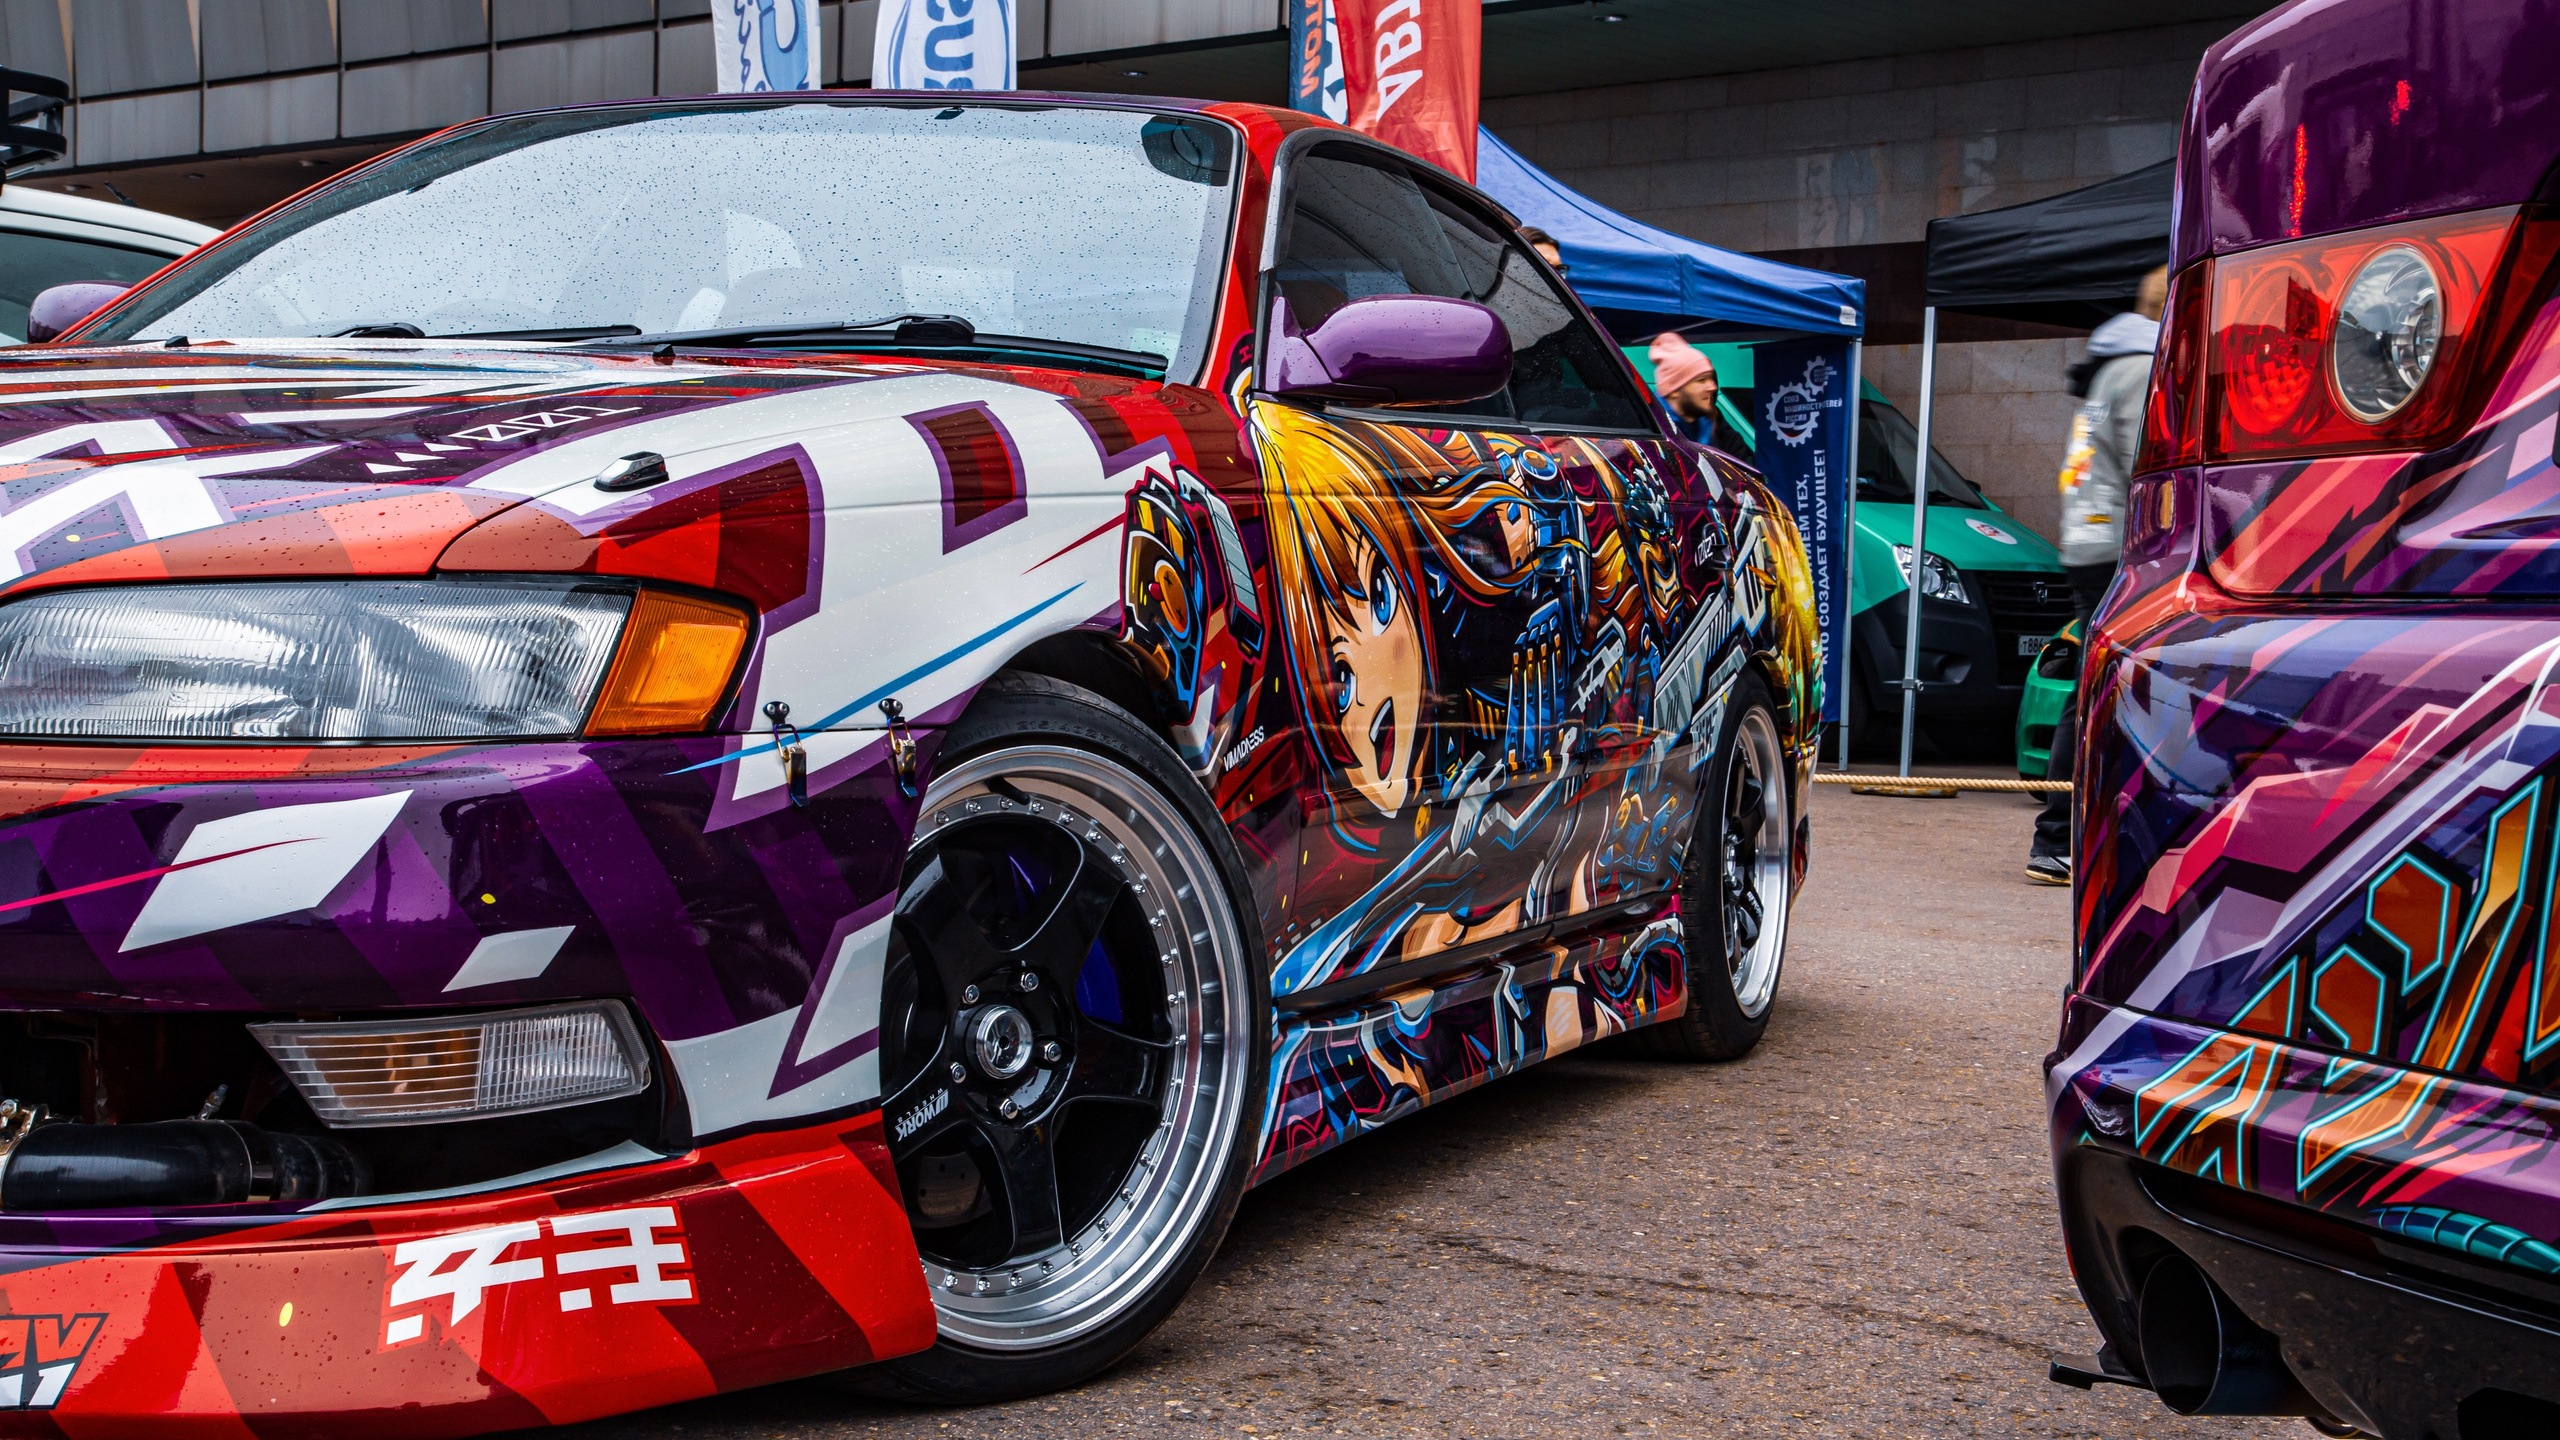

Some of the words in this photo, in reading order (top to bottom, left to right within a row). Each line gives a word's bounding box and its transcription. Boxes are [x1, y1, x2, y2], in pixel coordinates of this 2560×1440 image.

[1796, 473, 1810, 511] ТЕХ,
[1813, 449, 1828, 541] БУДУЩЕЕ!
[1817, 545, 1830, 627] СОЗДАЕТ
[895, 1103, 937, 1141] WORK
